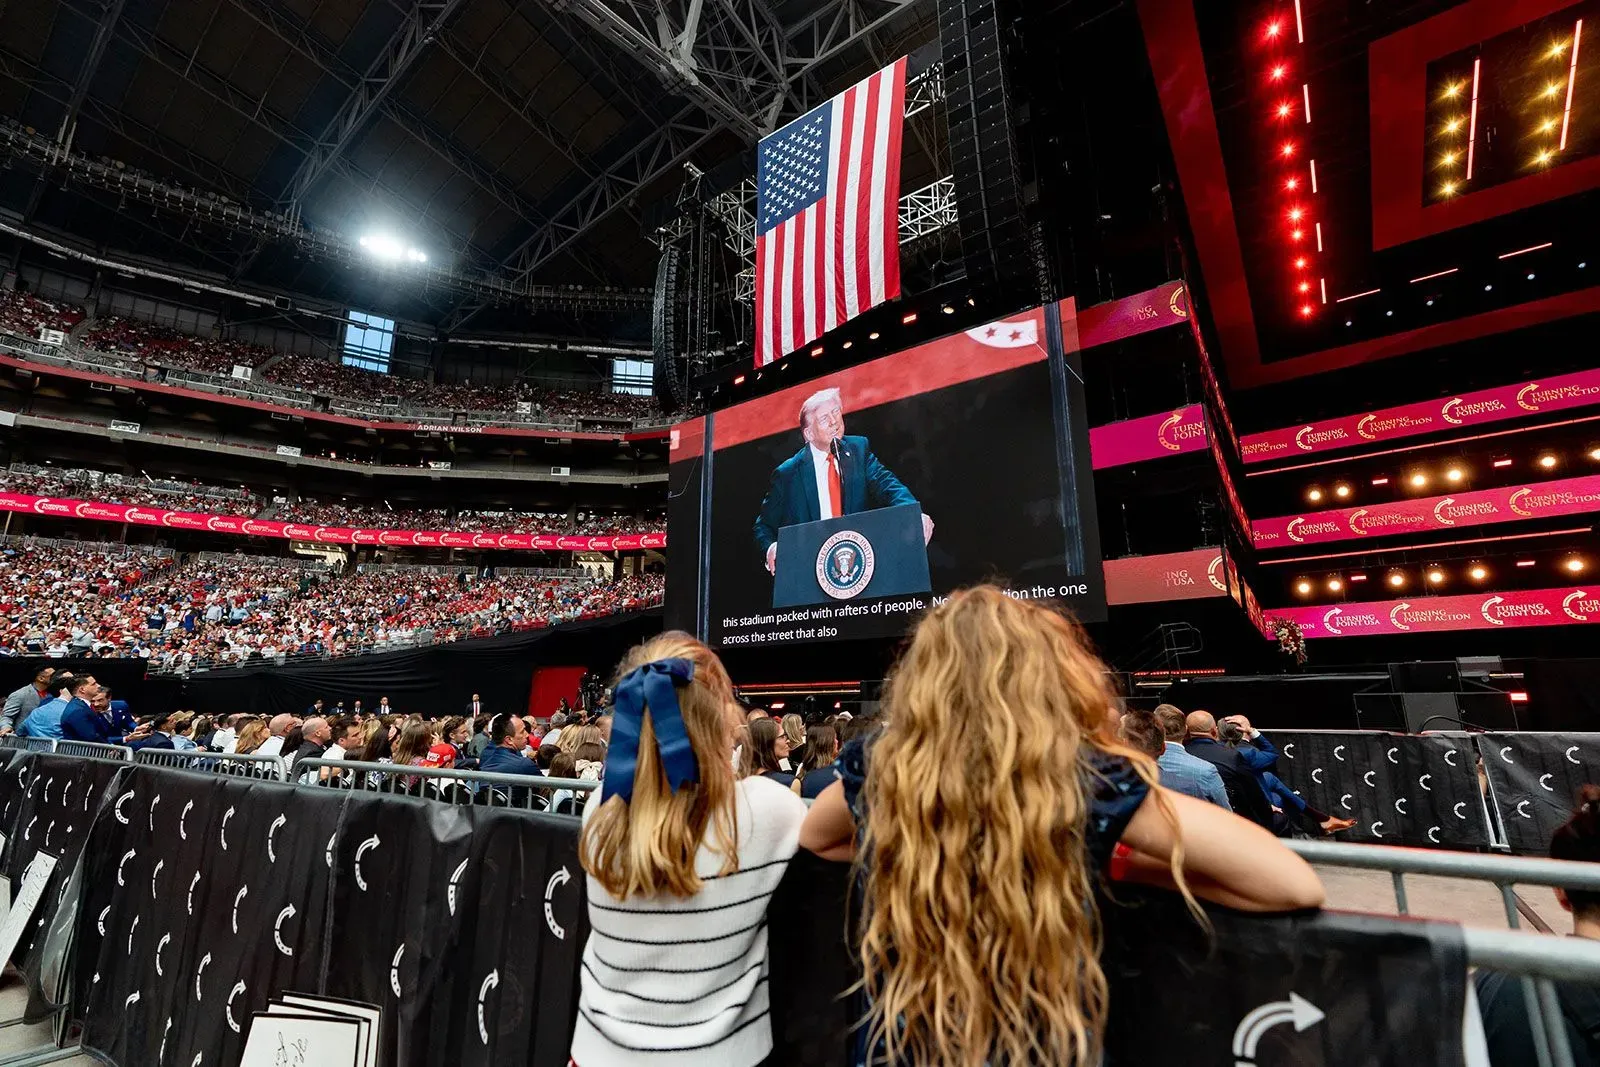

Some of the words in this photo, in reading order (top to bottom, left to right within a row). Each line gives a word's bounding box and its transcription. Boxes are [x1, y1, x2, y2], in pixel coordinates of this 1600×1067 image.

[1139, 311, 1158, 320] USA
[1530, 384, 1580, 398] TURNING
[1532, 393, 1566, 404] POINT
[1568, 386, 1600, 398] ACTIO
[1456, 399, 1500, 412] TURNING
[1456, 406, 1488, 417] POINT
[1488, 403, 1506, 413] USA
[1370, 416, 1410, 428] TURNING
[1370, 423, 1398, 433] POINT
[1400, 417, 1432, 428] ACTION
[1172, 422, 1202, 434] TURN
[1306, 428, 1344, 439] TURNING
[1174, 428, 1206, 440] POINT
[1307, 435, 1332, 445] POINT
[1333, 432, 1349, 442] USA
[1260, 443, 1288, 453] ACTION
[1523, 492, 1573, 503] TURNING
[1447, 502, 1492, 512] TURNING
[1525, 499, 1559, 508] POINT
[1361, 513, 1401, 524] TURNING
[1449, 508, 1479, 518] POINT
[1298, 521, 1336, 531] TURNING
[1361, 520, 1389, 528] POINT
[1390, 515, 1424, 526] ACTION
[1174, 577, 1194, 586] USA
[723, 618, 738, 627] this
[740, 614, 774, 626] stadium
[776, 611, 809, 625] packed
[811, 608, 832, 620] with
[834, 605, 869, 617] rafters
[871, 602, 883, 614] of
[884, 599, 926, 616] people.
[1032, 585, 1056, 598] the
[1060, 583, 1088, 596] one
[1495, 603, 1544, 612] TURNING
[1335, 614, 1376, 622] TURNING
[1403, 609, 1447, 617] TURNING
[1435, 613, 1471, 622] ACTION
[1497, 610, 1530, 618] POINT
[1531, 607, 1551, 616] USA
[723, 633, 750, 645] across
[751, 631, 766, 643] the
[768, 629, 794, 641] street
[796, 628, 815, 639] that
[817, 626, 837, 637] also
